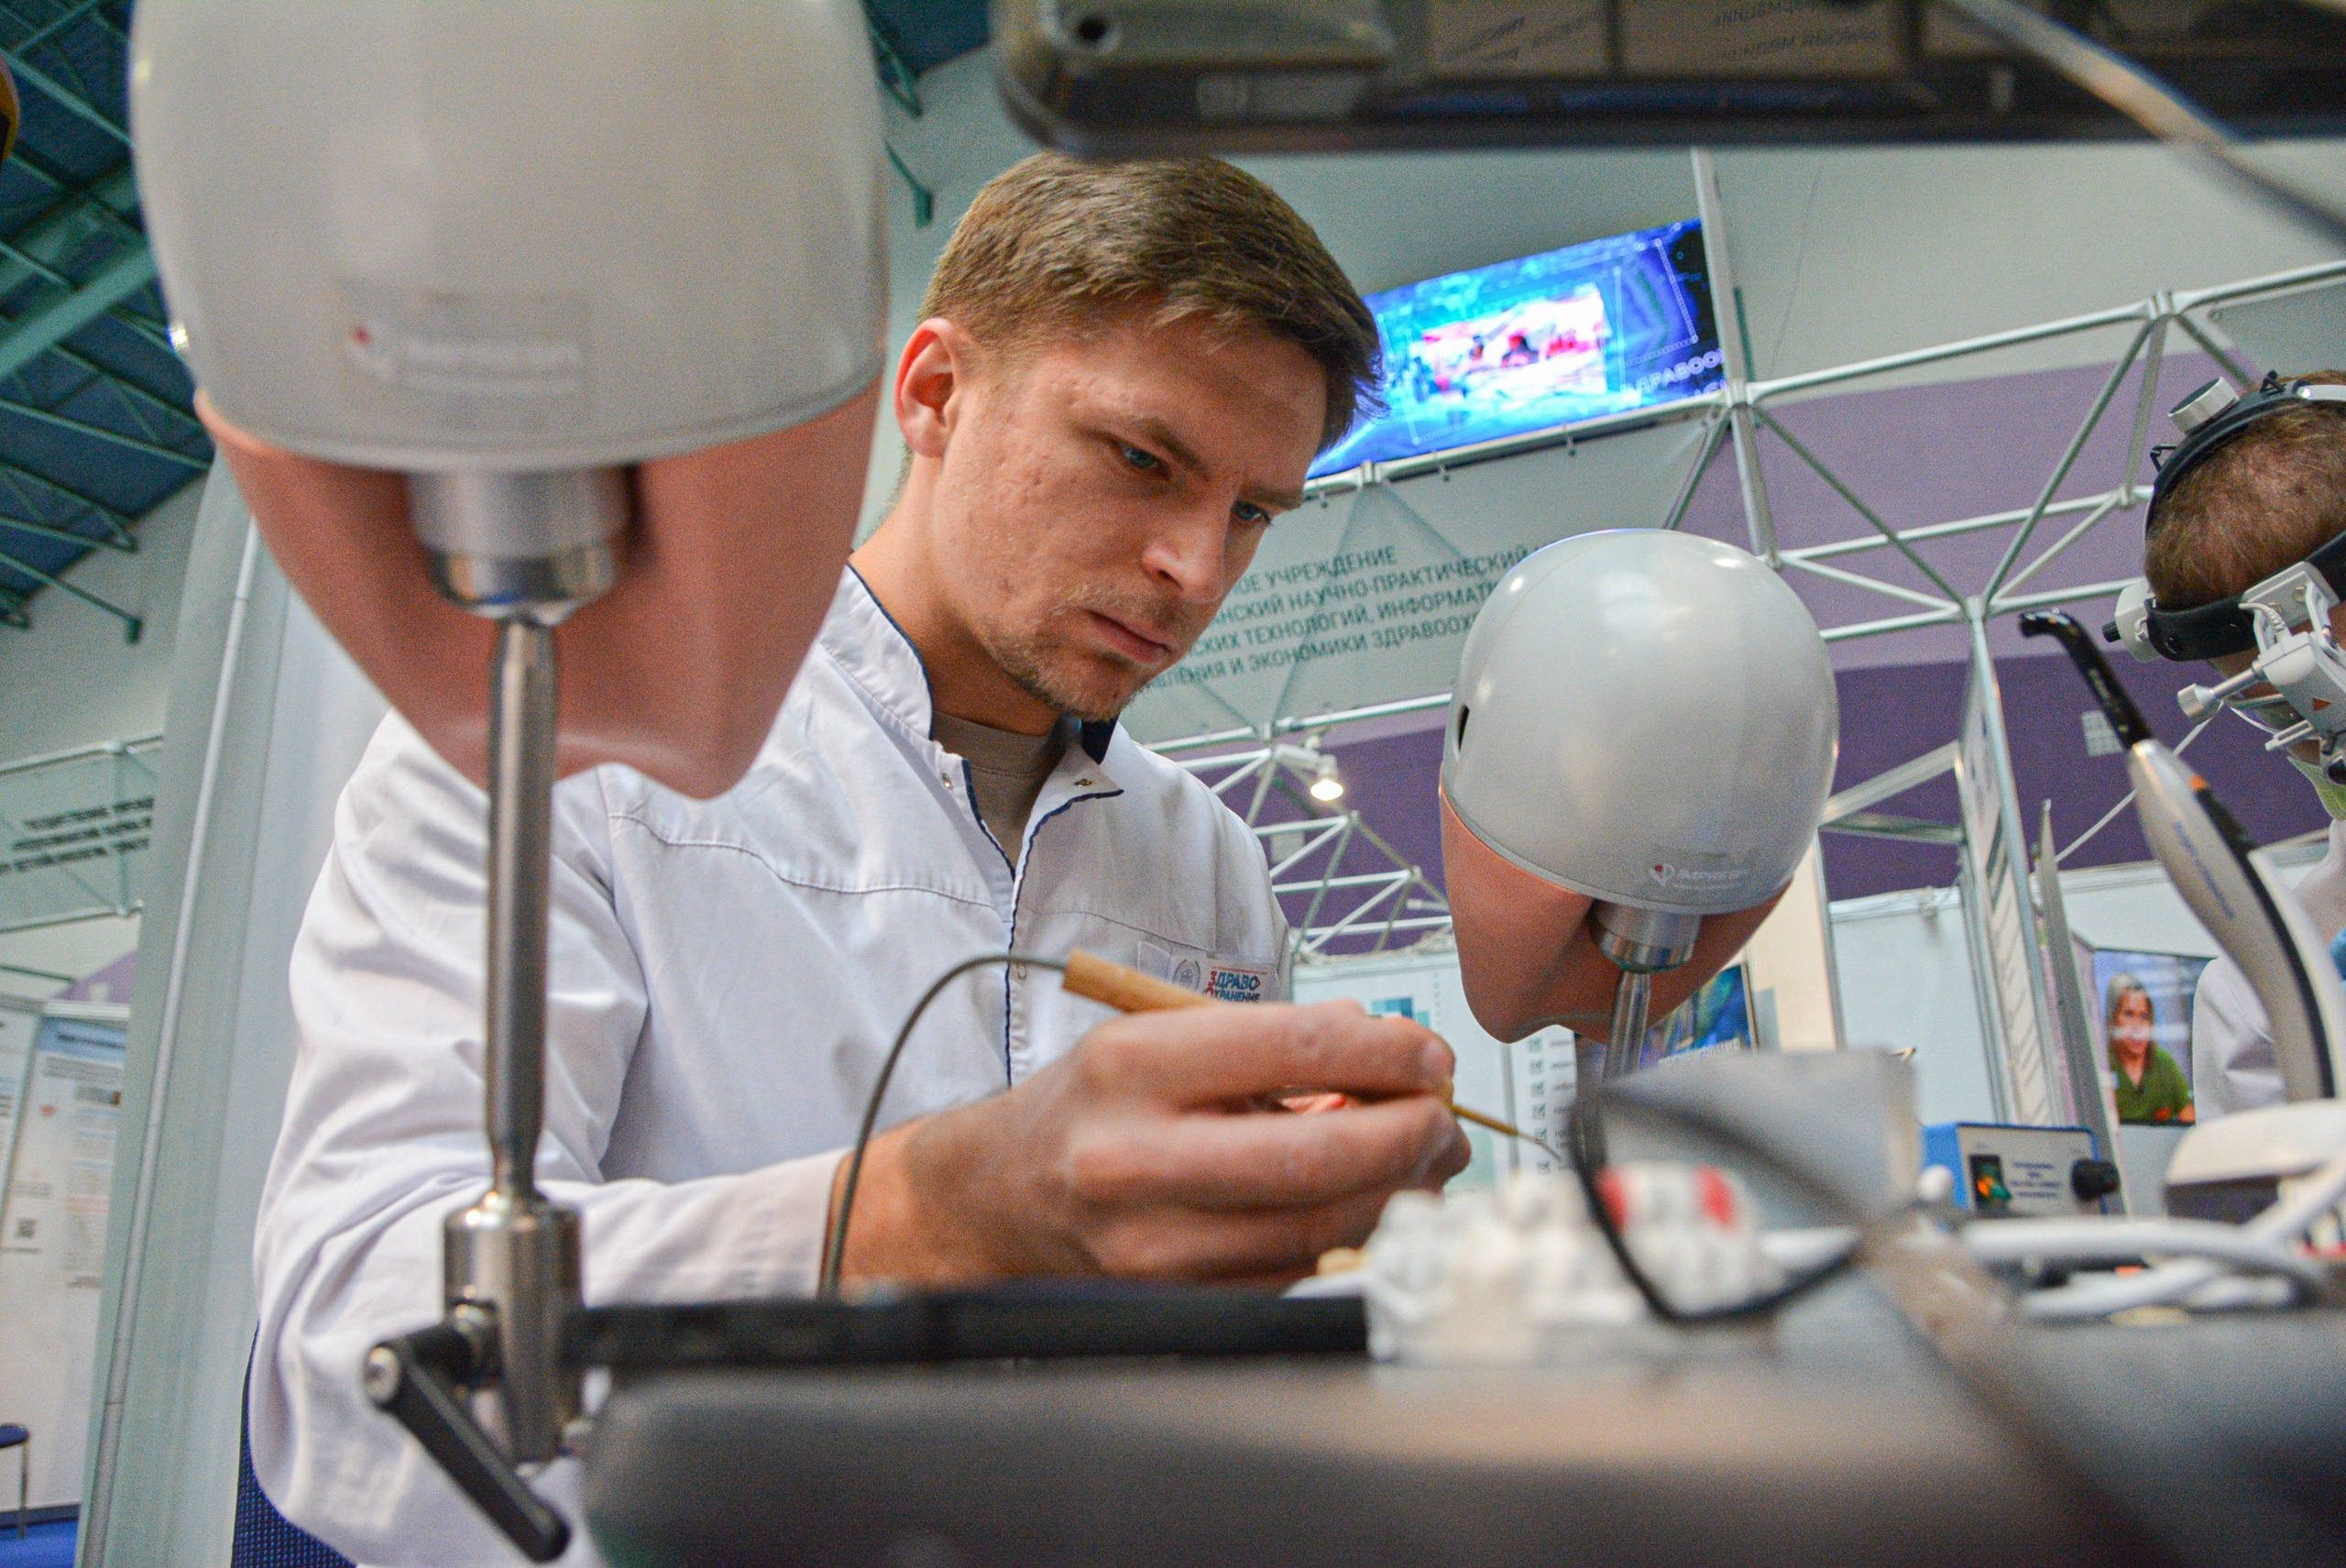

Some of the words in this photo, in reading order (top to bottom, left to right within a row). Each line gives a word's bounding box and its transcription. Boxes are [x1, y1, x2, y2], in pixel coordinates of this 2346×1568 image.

[1265, 544, 1398, 587] УЧРЕЖДЕНИЕ
[1288, 544, 1528, 611] НАУЧНО-ПРАКТИЧЕСКИЙ
[1229, 657, 1245, 675] И
[1248, 633, 1369, 673] ЭКОНОМИКИ
[1374, 611, 1478, 649] ЗДРАВООХ
[1244, 602, 1374, 645] ТЕХНОЛОГИЙ,
